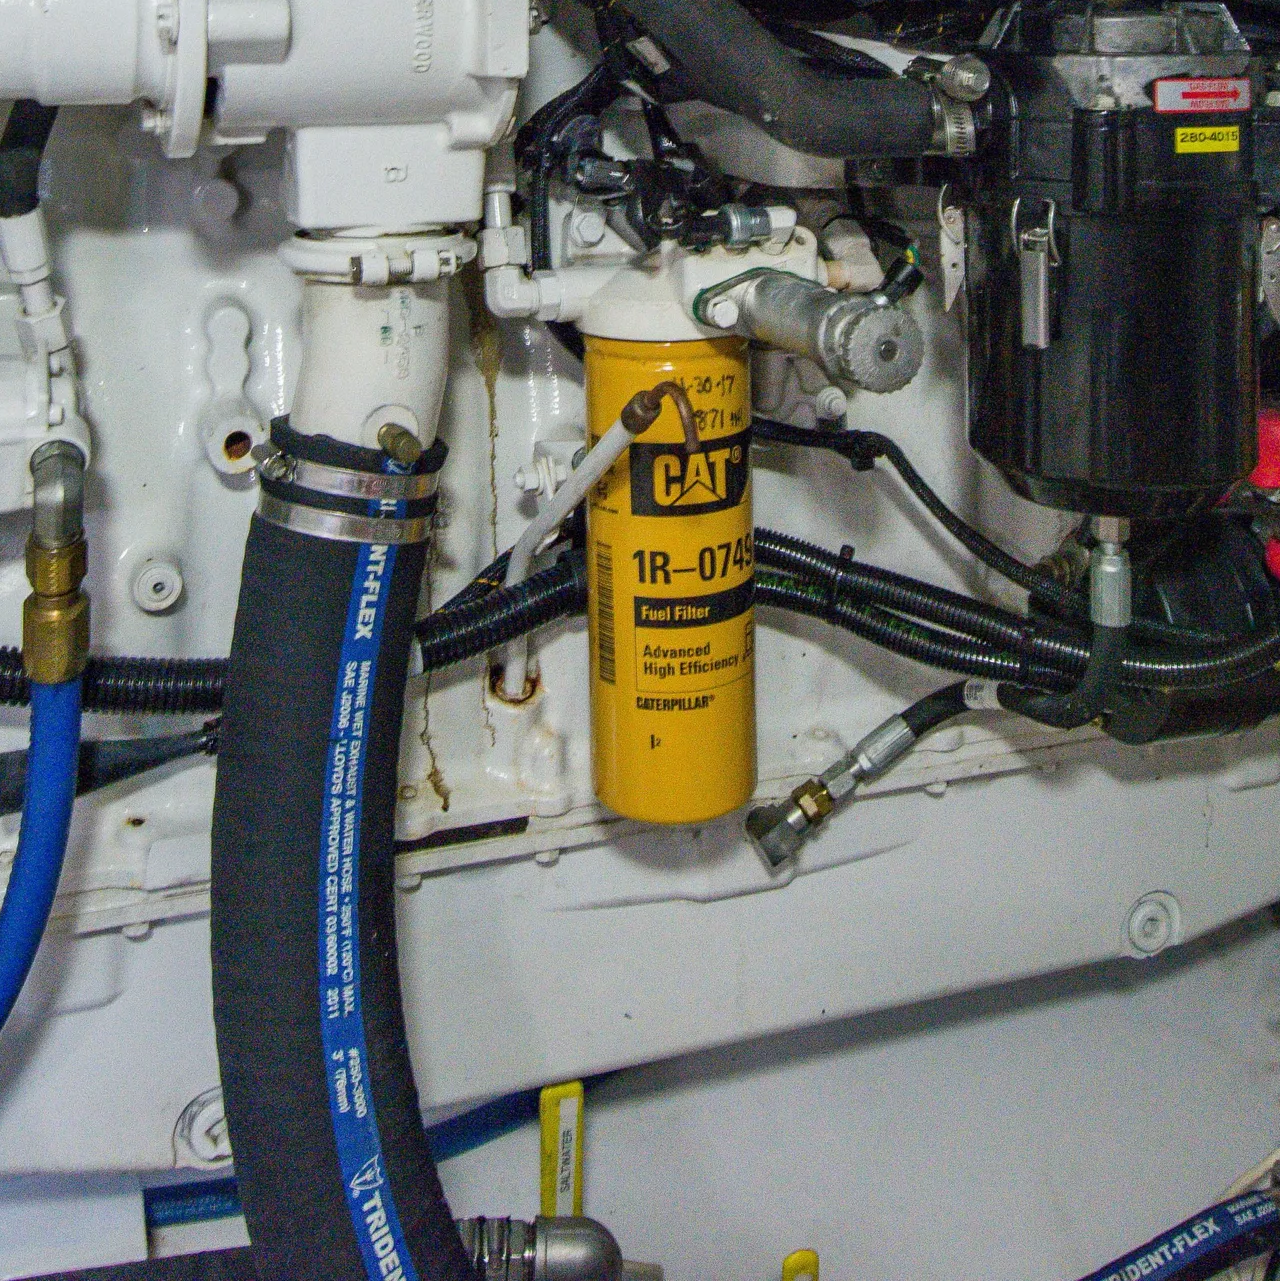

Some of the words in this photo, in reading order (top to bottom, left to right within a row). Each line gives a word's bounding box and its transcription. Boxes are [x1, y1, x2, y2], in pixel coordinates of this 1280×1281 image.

[1180, 131, 1238, 143] 280-4015
[653, 448, 729, 508] CAT
[640, 605, 670, 622] Fuel
[673, 604, 711, 620] Filter
[643, 641, 711, 659] Advanced
[342, 661, 358, 688] SAE
[643, 661, 676, 680] High
[679, 655, 740, 677] Efficiency
[356, 661, 371, 708] MARINE
[636, 694, 710, 712] CATERPILLAR
[353, 710, 364, 737] WET
[326, 798, 342, 872] APPROVED
[342, 811, 355, 854] WATER
[341, 856, 353, 893] HOSE
[324, 877, 338, 912] CERT
[559, 1128, 573, 1194] SALTWATER
